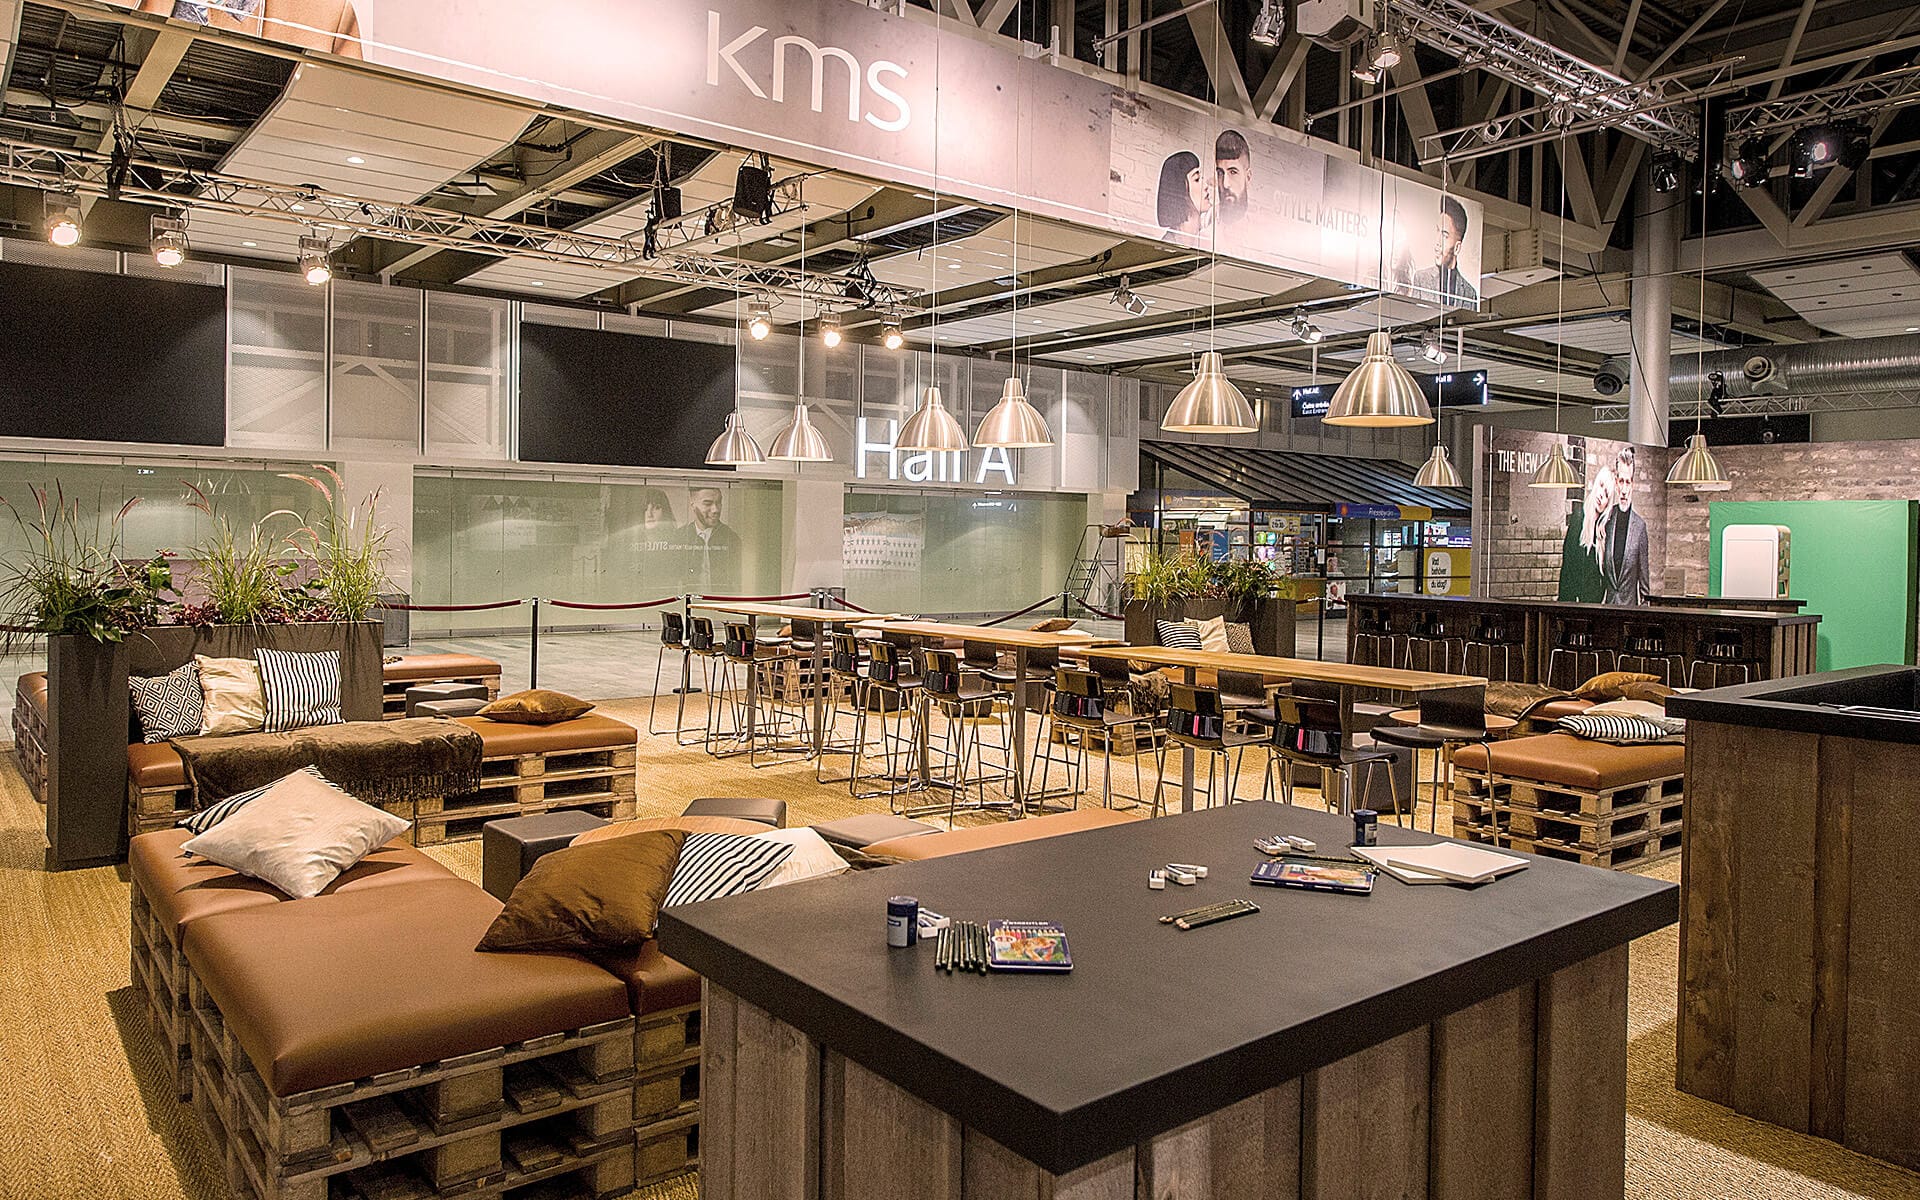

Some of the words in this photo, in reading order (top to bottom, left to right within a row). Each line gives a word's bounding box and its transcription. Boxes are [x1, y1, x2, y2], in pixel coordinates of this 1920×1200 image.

[706, 10, 911, 132] kms
[1273, 190, 1312, 224] STYLE
[1315, 202, 1369, 238] MATTERS
[856, 417, 961, 482] Hall
[975, 446, 1017, 485] A
[1498, 450, 1515, 472] THE
[1517, 451, 1538, 473] NEW
